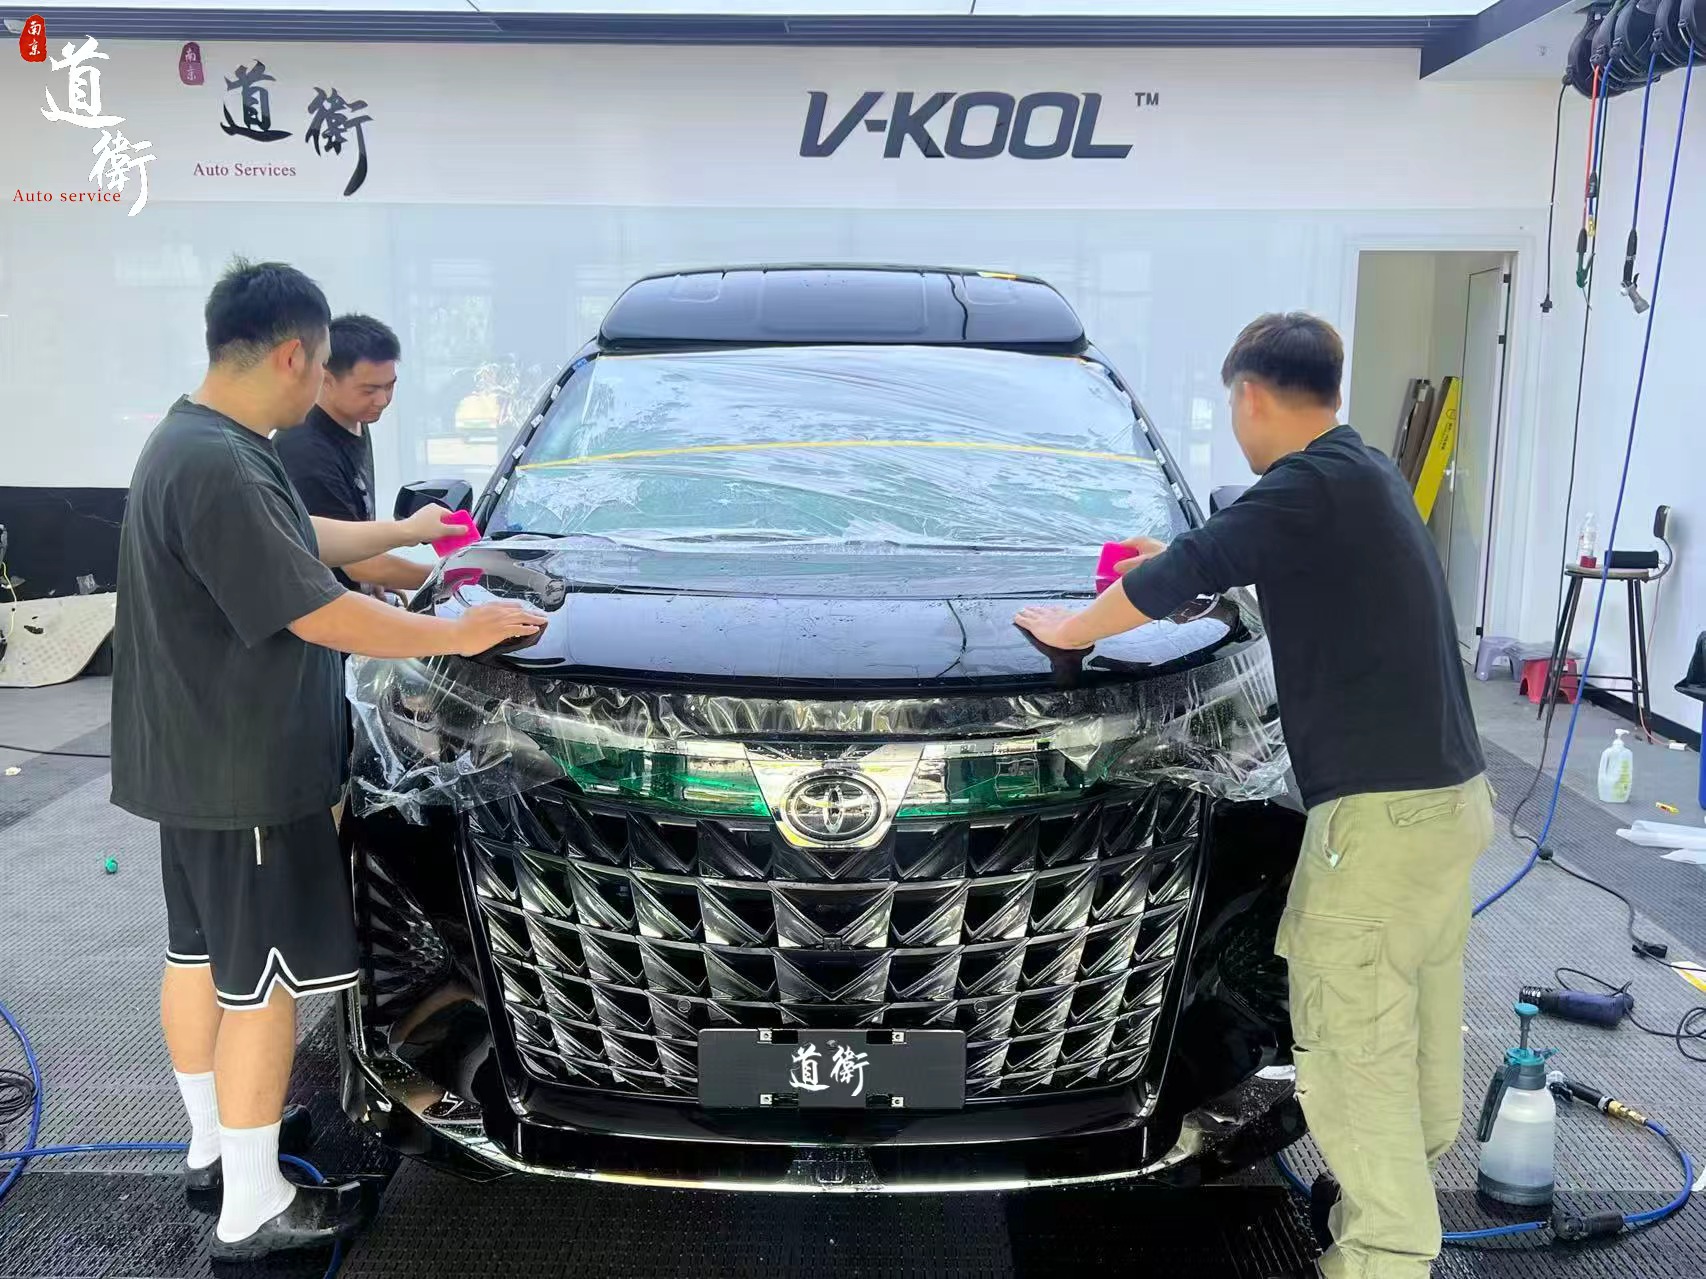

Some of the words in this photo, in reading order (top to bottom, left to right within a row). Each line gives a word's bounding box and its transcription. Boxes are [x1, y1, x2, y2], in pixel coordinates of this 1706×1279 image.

[799, 91, 1134, 159] V-KOOL
[193, 163, 229, 177] Auto
[234, 162, 297, 177] Services
